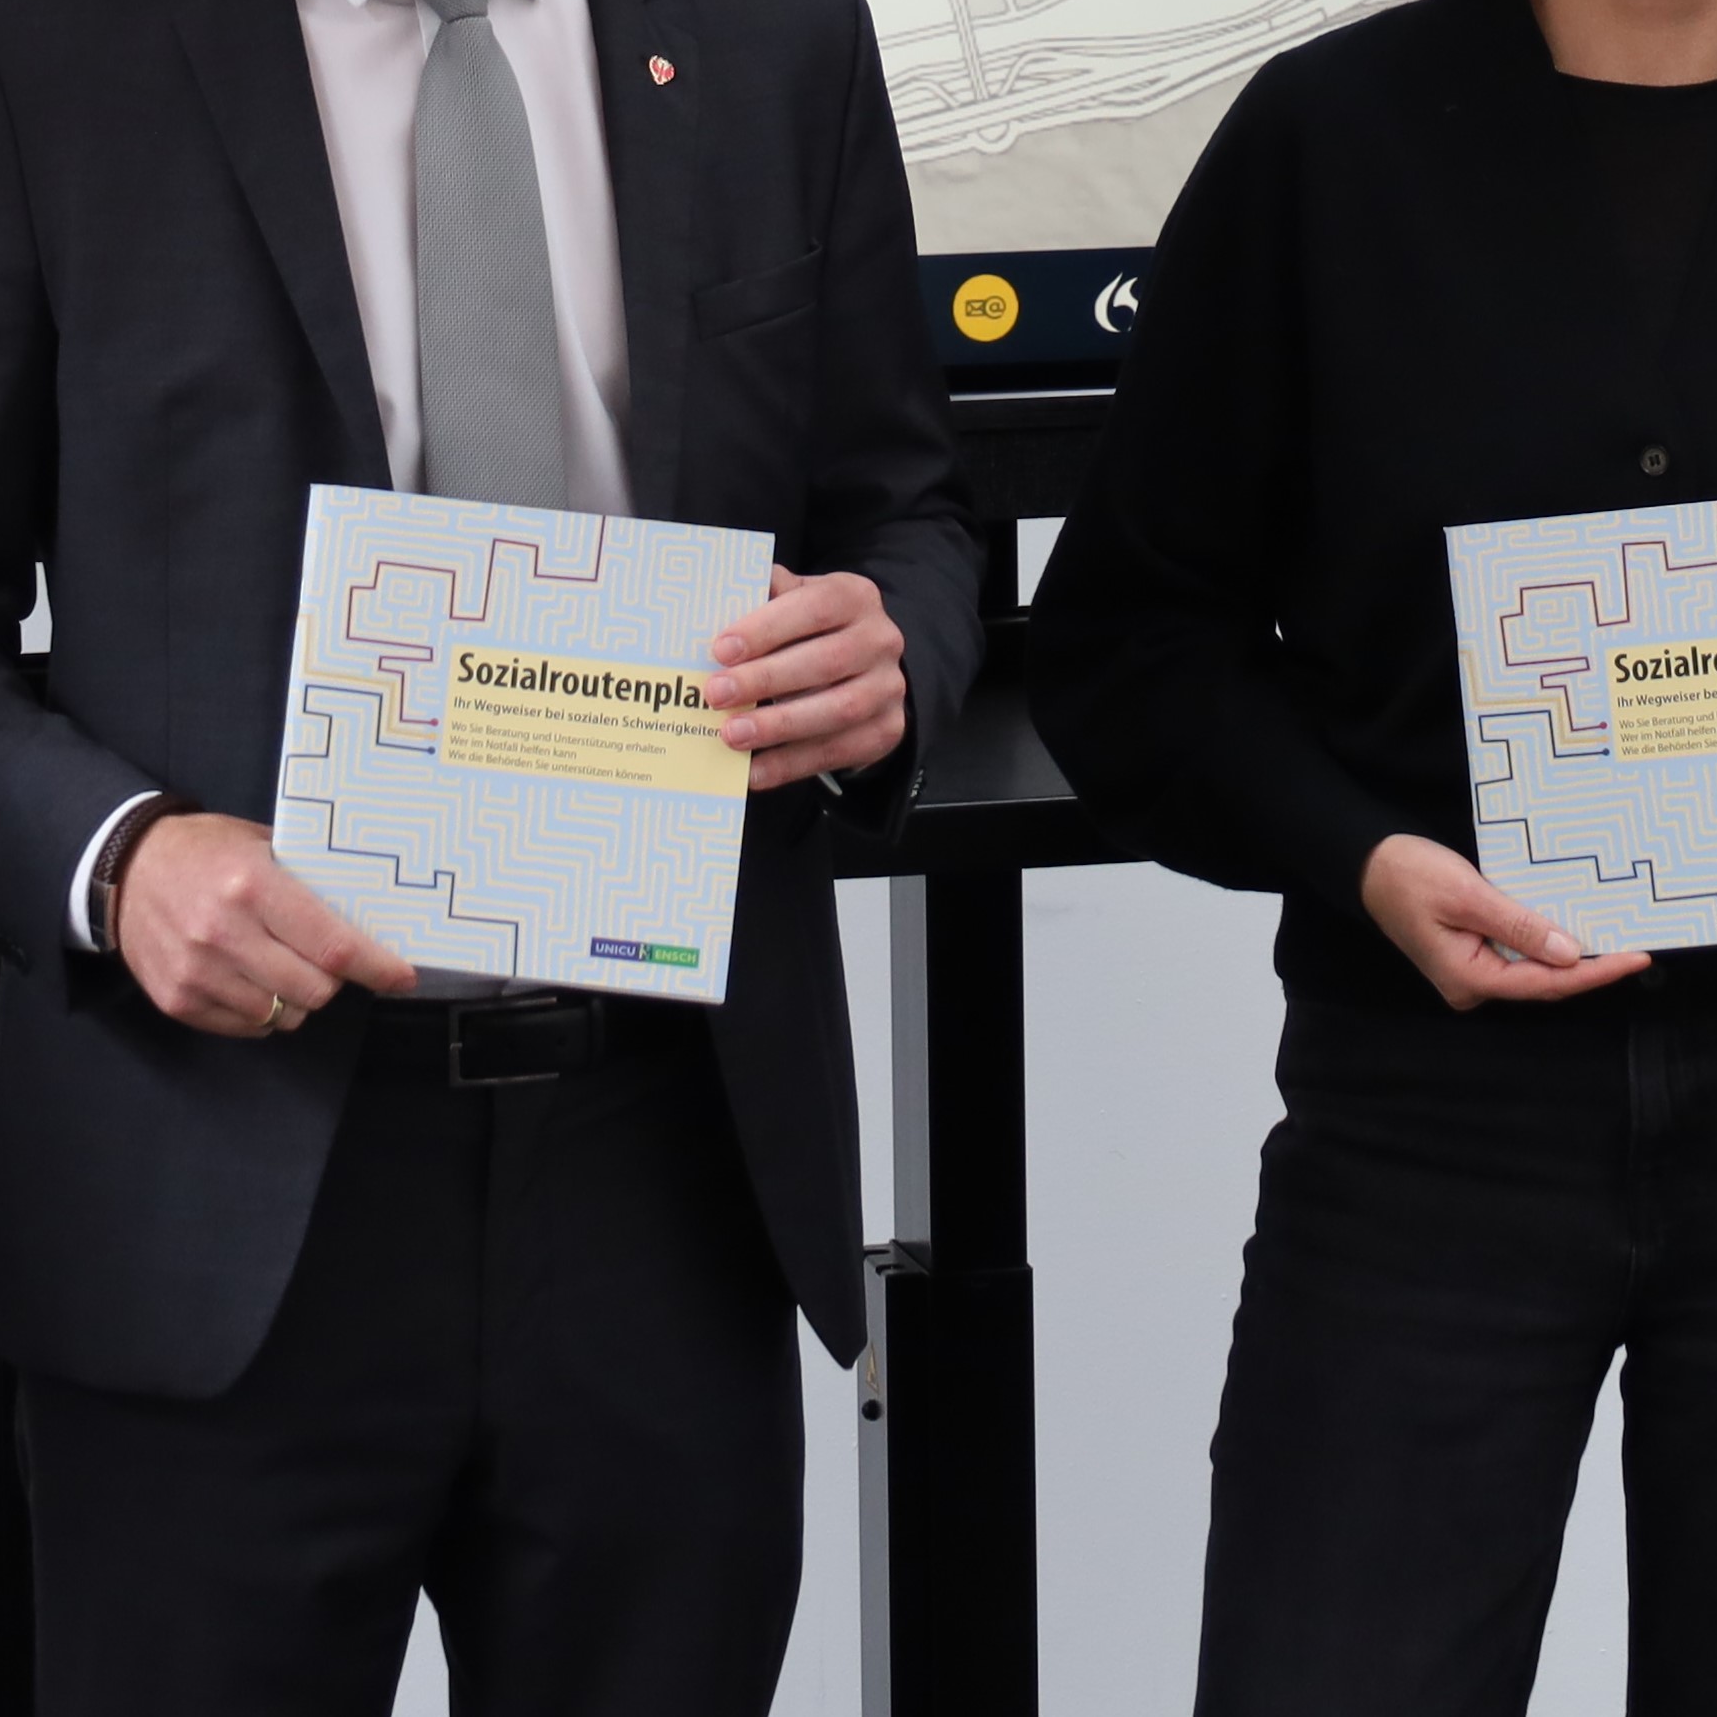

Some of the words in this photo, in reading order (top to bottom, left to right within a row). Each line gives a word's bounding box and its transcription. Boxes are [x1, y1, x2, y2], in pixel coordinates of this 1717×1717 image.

[1617, 695, 1634, 708] Ihr
[1635, 690, 1701, 708] Wegweiser
[453, 696, 472, 710] Ihr
[474, 698, 542, 720] Wegweiser
[545, 707, 565, 721] bei
[567, 710, 619, 727] sozialen
[1619, 719, 1635, 730] Wo
[1636, 716, 1651, 728] Sie
[1652, 713, 1694, 728] Beratung
[1696, 710, 1715, 722] und
[451, 720, 469, 732] Wo
[469, 722, 484, 734] Sie
[485, 724, 530, 741] Beratung
[532, 730, 552, 743] und
[554, 732, 624, 752] Unterstützung
[625, 740, 667, 756] erhalten
[1620, 733, 1639, 743] Wer
[1640, 731, 1653, 741] im
[1655, 727, 1685, 740] Notfall
[1687, 724, 1716, 737] helfen
[449, 735, 469, 747] Wer
[471, 737, 484, 748] im
[485, 739, 519, 753] Notfall
[519, 742, 551, 757] helfen
[553, 747, 577, 760] kann
[1621, 745, 1639, 756] Wie
[1641, 743, 1655, 754] die
[1657, 739, 1702, 753] Behörden
[1703, 738, 1717, 749] Sie
[448, 749, 468, 761] Wie
[470, 752, 484, 763] die
[485, 752, 533, 769] Behörden
[535, 759, 550, 772] Sie
[551, 761, 614, 778] unterstützen
[615, 768, 653, 782] können
